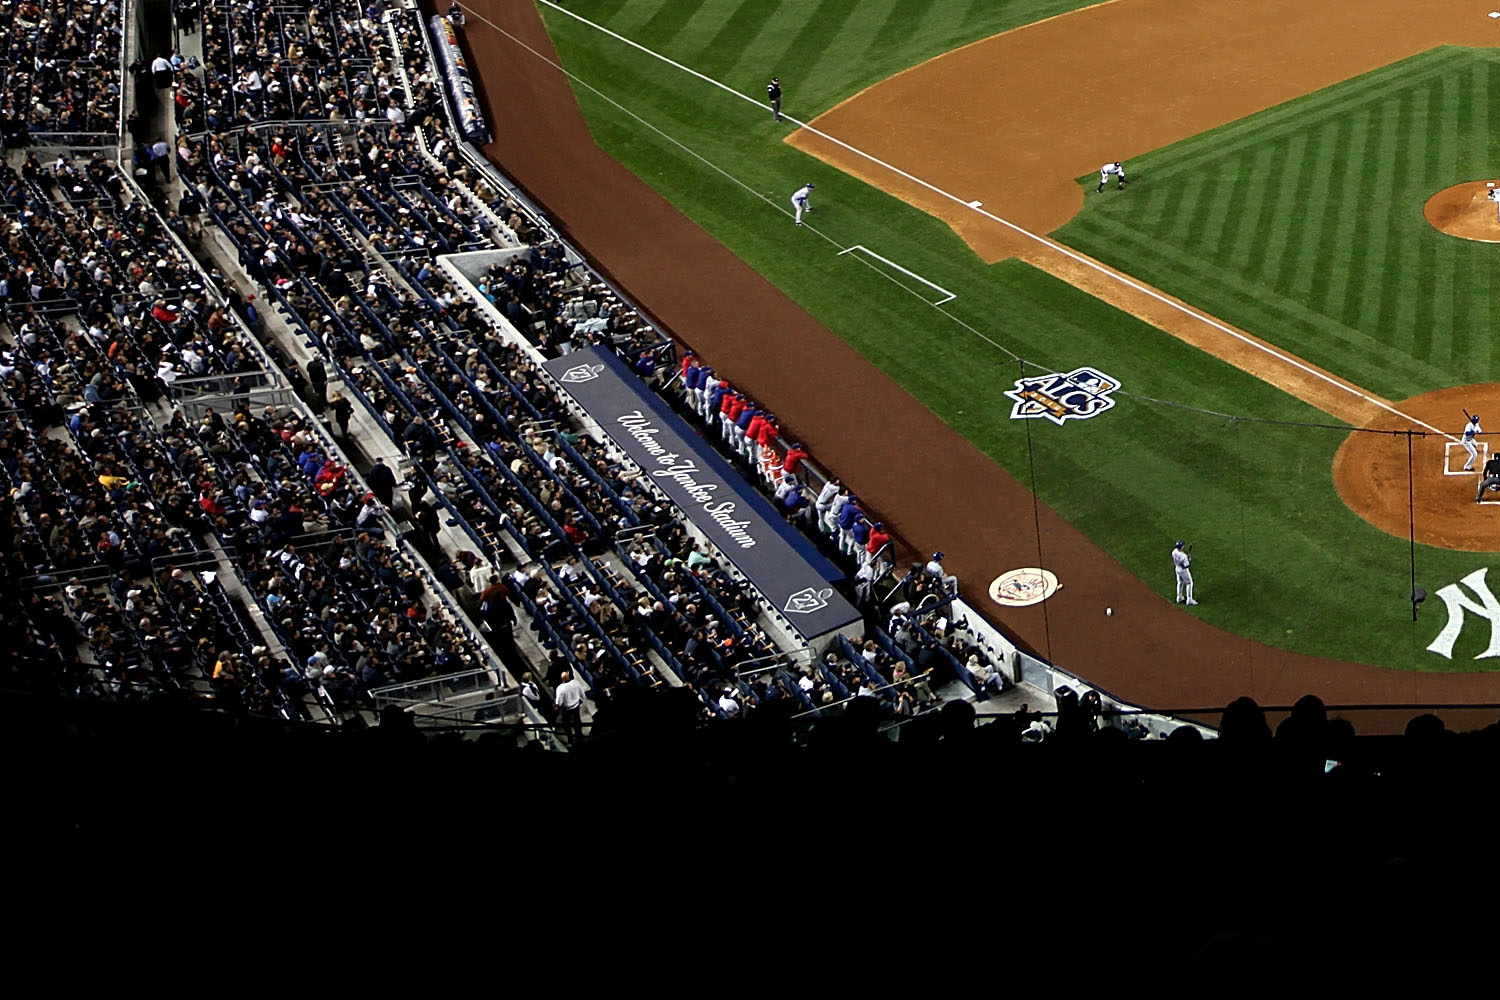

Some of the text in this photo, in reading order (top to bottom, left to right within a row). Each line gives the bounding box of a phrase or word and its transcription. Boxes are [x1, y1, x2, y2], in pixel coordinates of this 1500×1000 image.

[1024, 376, 1103, 415] ALCS
[617, 410, 757, 549] Welcome to Yankee Stadium
